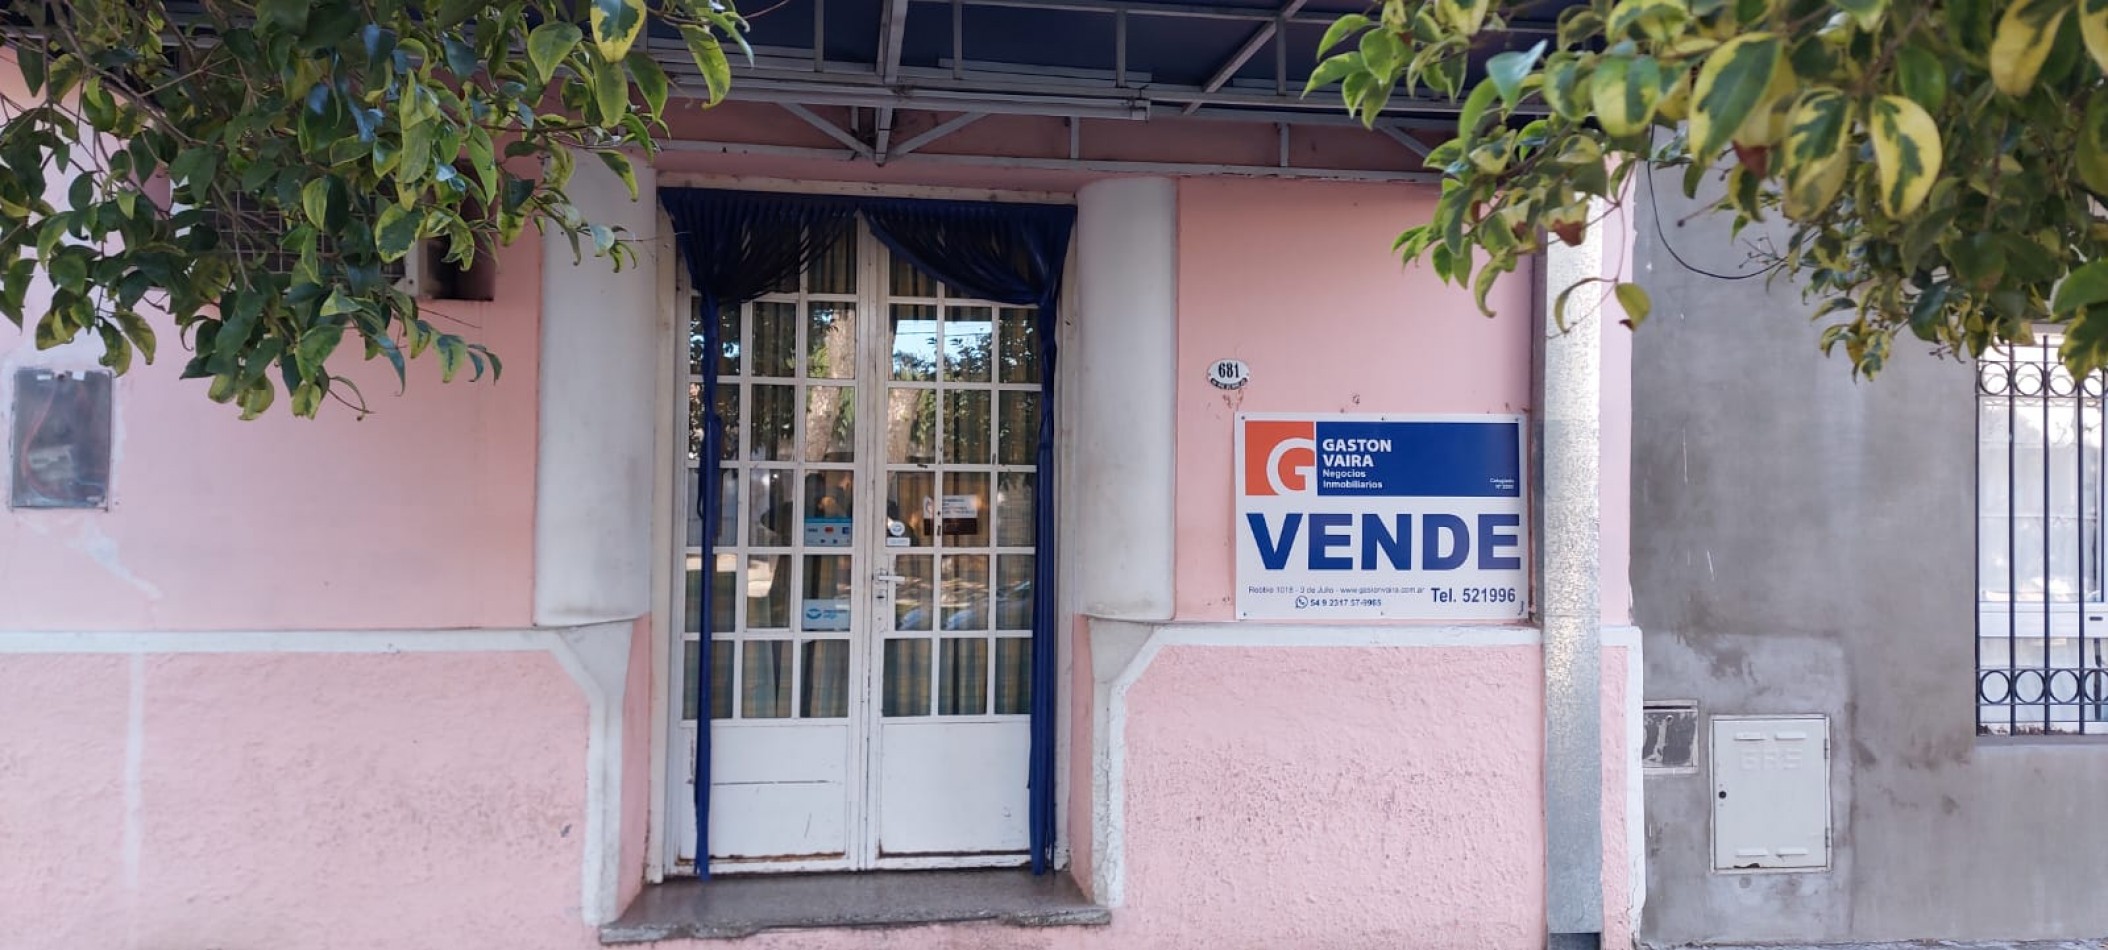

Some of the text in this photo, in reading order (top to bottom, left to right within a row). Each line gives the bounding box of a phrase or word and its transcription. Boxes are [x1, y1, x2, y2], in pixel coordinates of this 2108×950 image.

[1218, 361, 1240, 378] 681
[1322, 438, 1392, 452] GASTON
[1322, 454, 1374, 467] VAIRA
[1322, 469, 1366, 479] Negocios
[1323, 480, 1383, 489] Inmobiliarios
[1246, 513, 1521, 570] VENDE
[1431, 587, 1516, 602] Tel. 521996
[1310, 599, 1320, 607] 54
